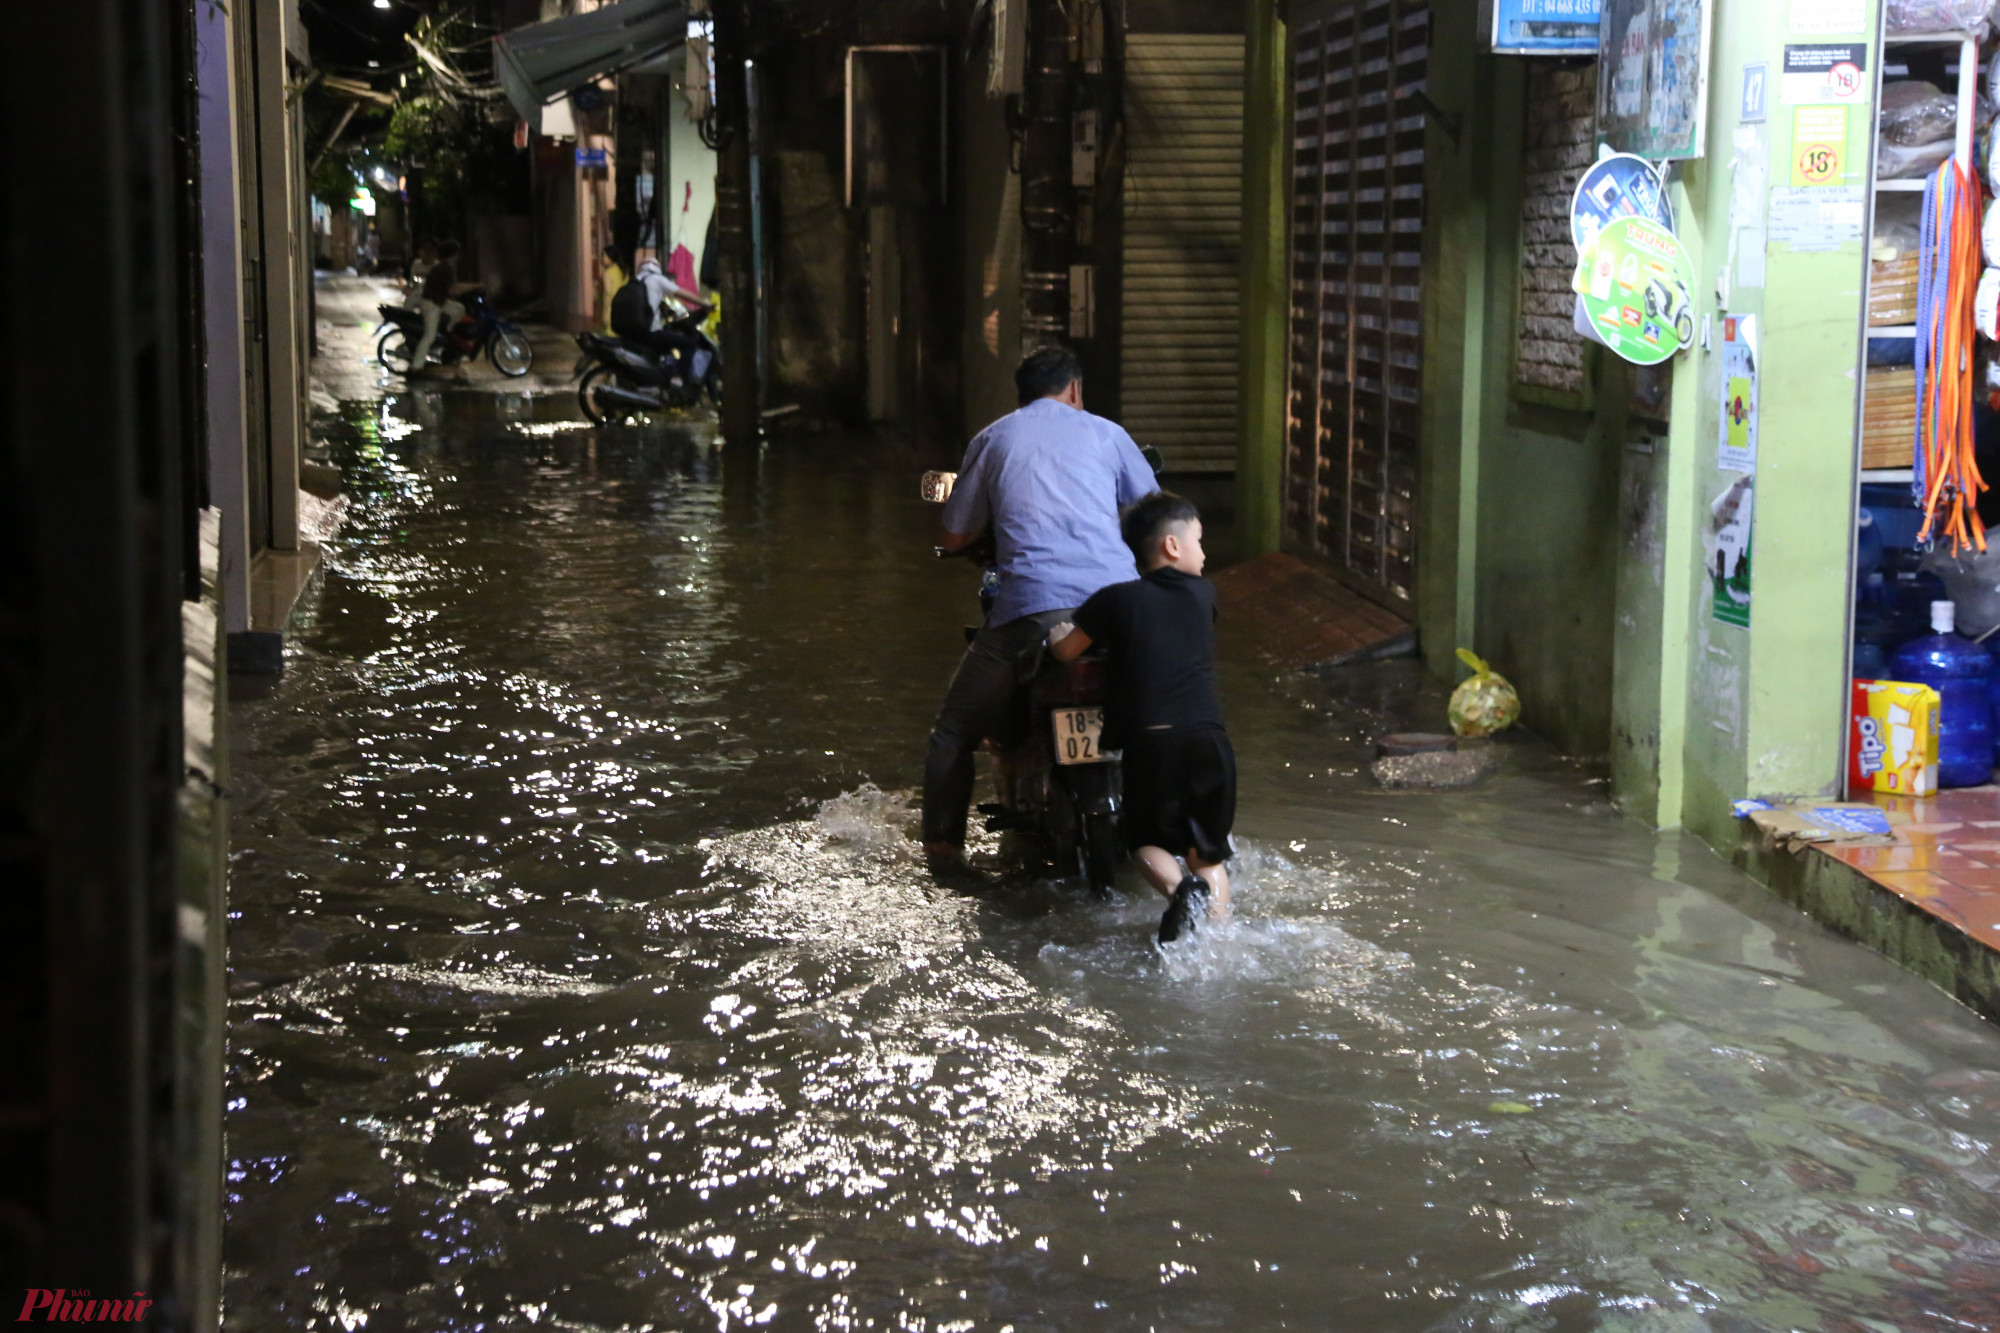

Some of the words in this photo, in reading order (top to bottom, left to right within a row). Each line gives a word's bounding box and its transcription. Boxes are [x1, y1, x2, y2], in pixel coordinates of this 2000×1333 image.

[1836, 73, 1853, 87] 18
[1745, 73, 1763, 112] 47
[1809, 151, 1828, 173] 18
[1066, 736, 1101, 759] 02
[1858, 716, 1886, 778] Tipo
